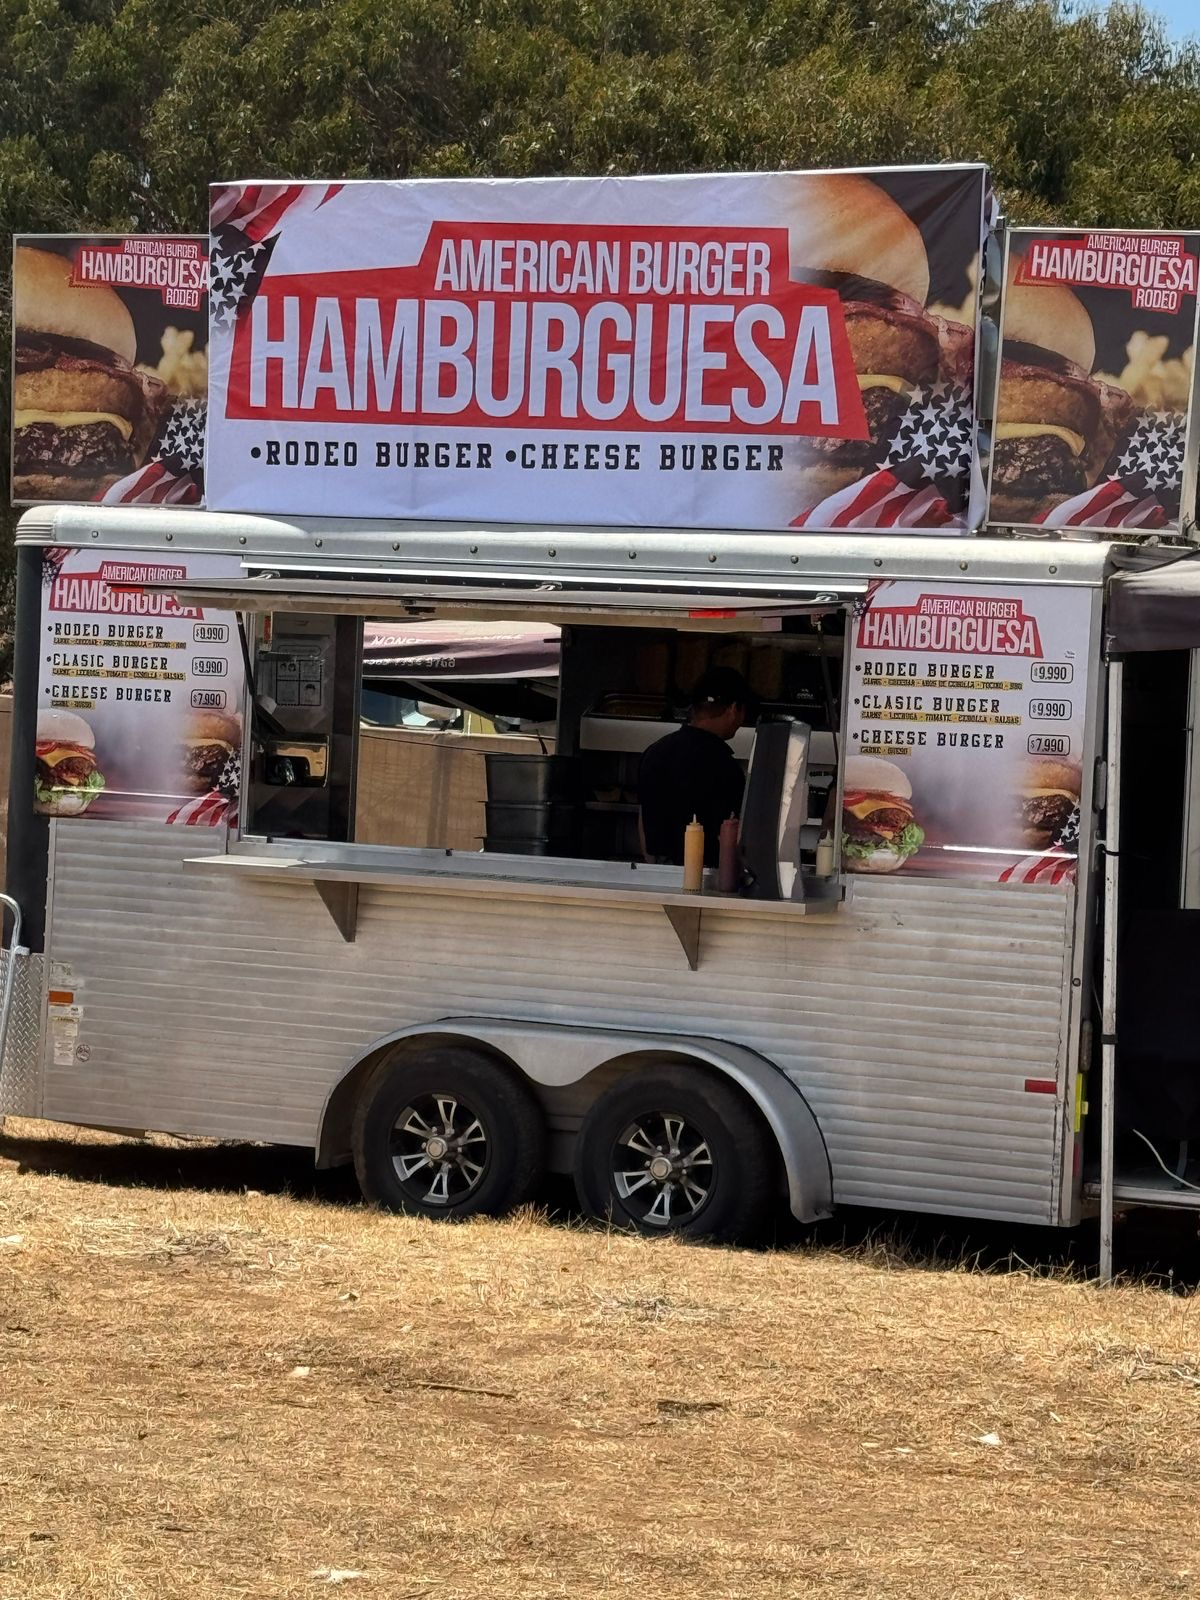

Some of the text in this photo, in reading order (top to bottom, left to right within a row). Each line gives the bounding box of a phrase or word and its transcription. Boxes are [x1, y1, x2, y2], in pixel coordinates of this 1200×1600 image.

[124, 240, 198, 258] AMERICAN BURGER
[1088, 234, 1179, 256] AMERICAN BURGER
[82, 250, 210, 290] HAMBURGUESA
[434, 238, 770, 296] AMERICAN BURGER
[1031, 246, 1194, 291] HAMBURGUESA
[166, 288, 199, 307] RODEO
[1136, 288, 1178, 310] RODEO
[250, 296, 839, 425] HAMBURGUESA
[266, 441, 493, 469] RODEO BURGER
[521, 443, 784, 471] CHEESE BURGER
[102, 565, 183, 581] AMERICAN BURGER
[920, 598, 1018, 618] AMERICAN BURGER
[55, 622, 164, 640] RODEO BURGER
[864, 612, 1036, 654] HAMBURGUESA
[54, 653, 168, 670] CLASIC BURGER
[864, 661, 995, 680] RODEO BURGER
[1034, 666, 1067, 680] $9.990
[52, 685, 172, 702] CHEESE BURGER
[193, 692, 221, 706] $7.990
[862, 695, 1000, 713] CLASIC BURGER
[1032, 702, 1066, 717] $9.990
[861, 730, 1004, 749] CHEESE BURGER
[1030, 738, 1064, 752] $7.990
